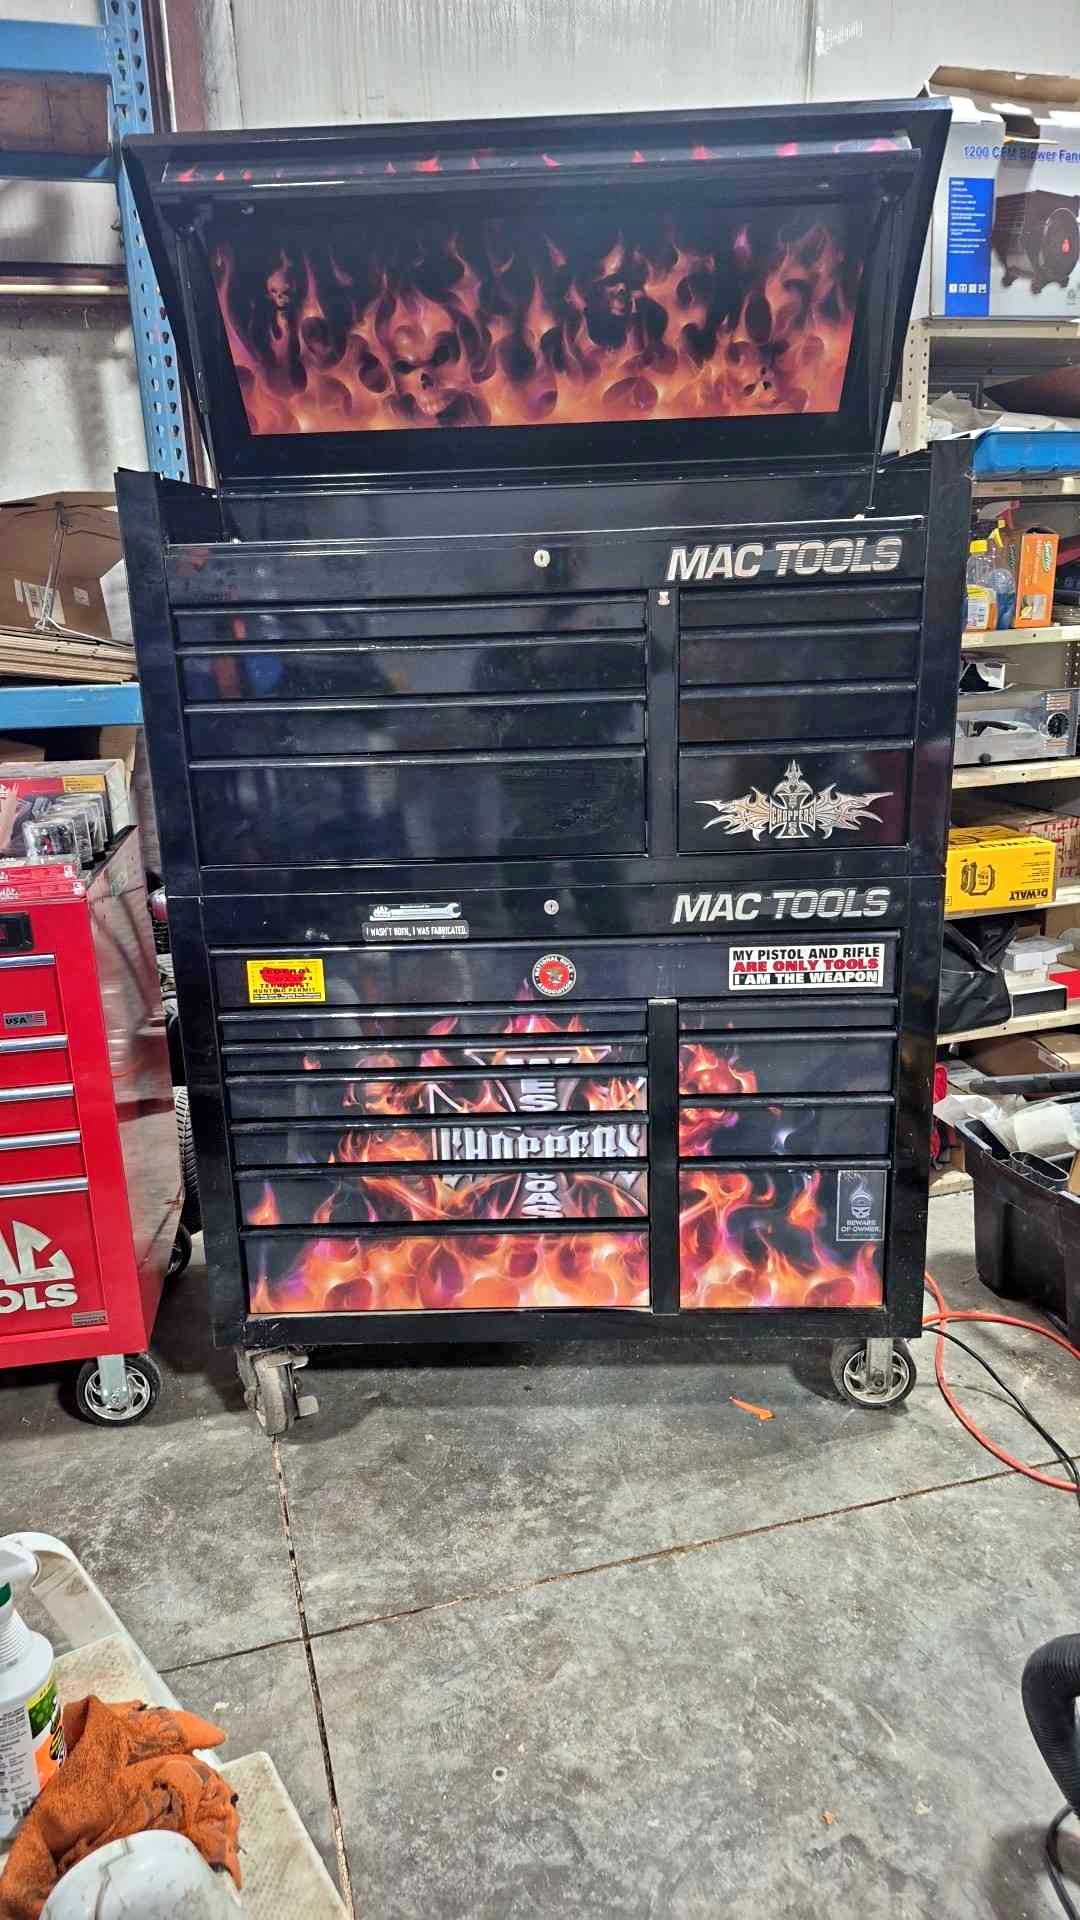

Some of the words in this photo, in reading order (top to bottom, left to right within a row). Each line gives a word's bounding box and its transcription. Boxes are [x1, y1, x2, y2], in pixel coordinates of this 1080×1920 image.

[964, 146, 989, 159] 1200
[1020, 148, 1057, 161] Blower
[1059, 149, 1080, 162] Fan
[666, 543, 764, 581] MAC
[774, 537, 903, 577] TOOLS
[770, 806, 816, 825] CHOPPERS
[672, 892, 762, 924] MAC
[772, 887, 891, 920] TOOLS
[416, 926, 430, 936] WAS
[733, 950, 753, 961] MY
[757, 949, 804, 961] PISTOL
[808, 948, 838, 959] AND
[842, 946, 880, 958] RIFLE
[733, 961, 767, 973] ARE
[773, 960, 819, 972] ONLY
[823, 958, 879, 970] TOOLS
[734, 973, 740, 985] I
[744, 972, 771, 985] AM
[774, 972, 805, 984] THE
[808, 970, 878, 984] WEAPON
[5, 1016, 27, 1025] USA
[840, 1225, 850, 1233] OF
